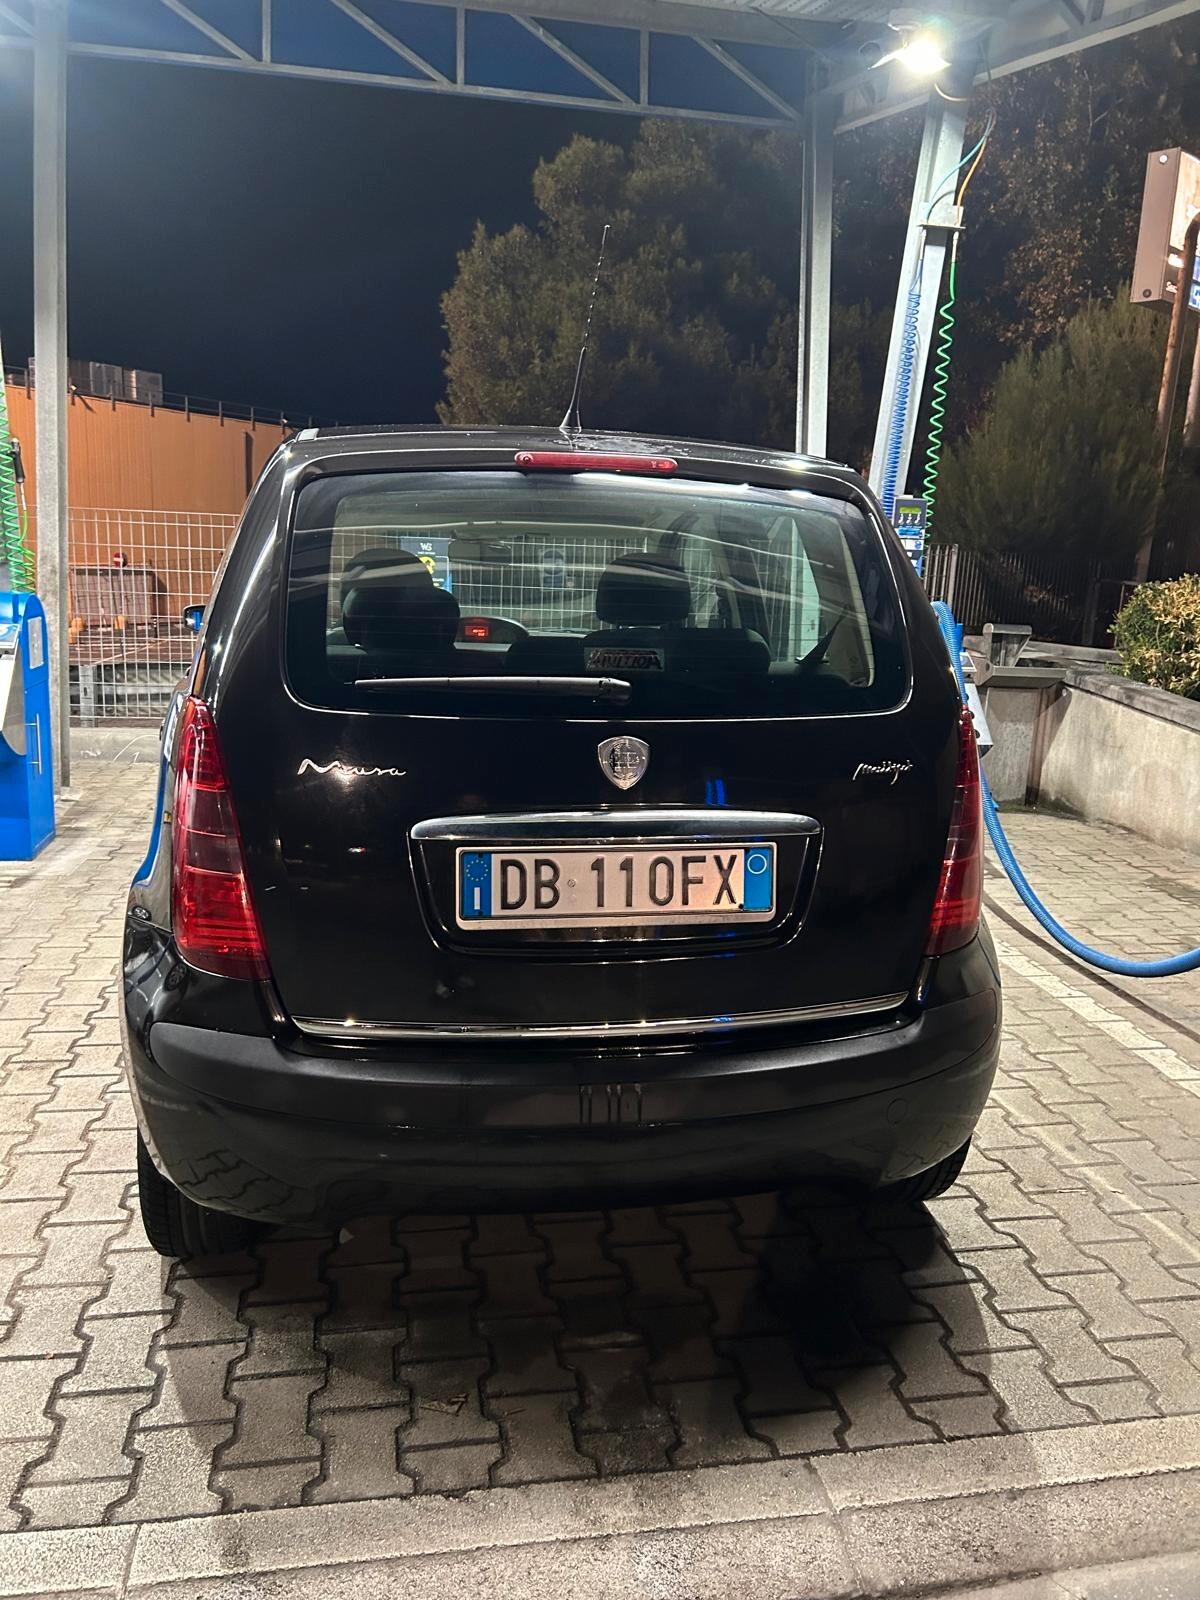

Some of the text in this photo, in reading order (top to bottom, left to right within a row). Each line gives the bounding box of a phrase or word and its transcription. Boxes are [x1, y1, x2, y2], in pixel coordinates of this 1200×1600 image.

[297, 758, 407, 776] Musa
[500, 854, 738, 911] DB 110FX
